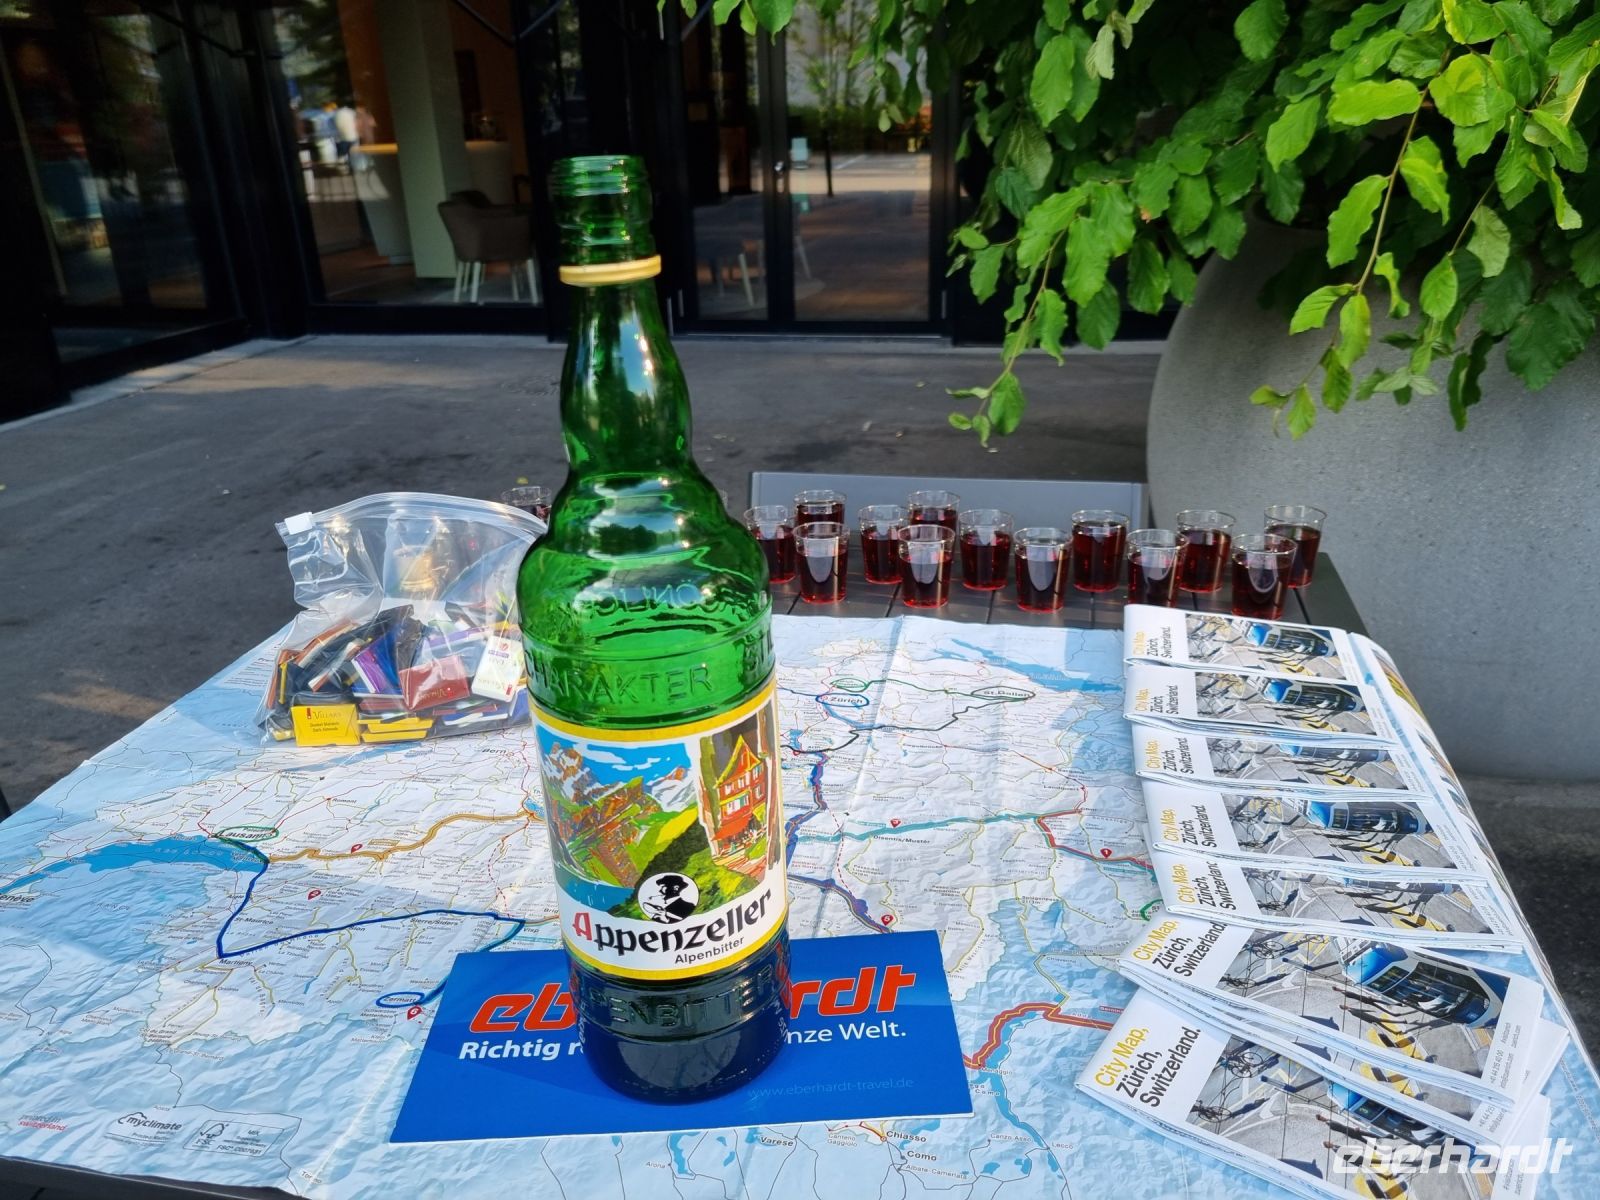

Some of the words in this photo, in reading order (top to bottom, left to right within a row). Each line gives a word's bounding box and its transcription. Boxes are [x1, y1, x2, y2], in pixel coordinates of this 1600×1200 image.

[1162, 826, 1179, 841] City
[0, 894, 35, 903] enève
[1177, 885, 1195, 903] City
[572, 887, 772, 956] Appenzeller
[674, 937, 745, 964] Alpenbitter
[1132, 940, 1162, 960] City
[1152, 937, 1194, 970] Zürich,
[1173, 921, 1228, 977] Switzerland.
[786, 1028, 833, 1044] nze
[838, 1020, 907, 1041] Welt.
[1111, 1027, 1150, 1058] Map,
[459, 1038, 560, 1061] Richtig
[1095, 1057, 1128, 1087] City
[1115, 1050, 1163, 1098] Zürich,
[1139, 1026, 1202, 1107] Switzerland.
[751, 1077, 914, 1097] www.eberhardt-travel.de
[126, 1116, 183, 1131] myclimate
[761, 1136, 794, 1147] Varese
[886, 1131, 927, 1143] Chiasso
[907, 1150, 938, 1162] Como
[301, 1170, 322, 1184] Torno
